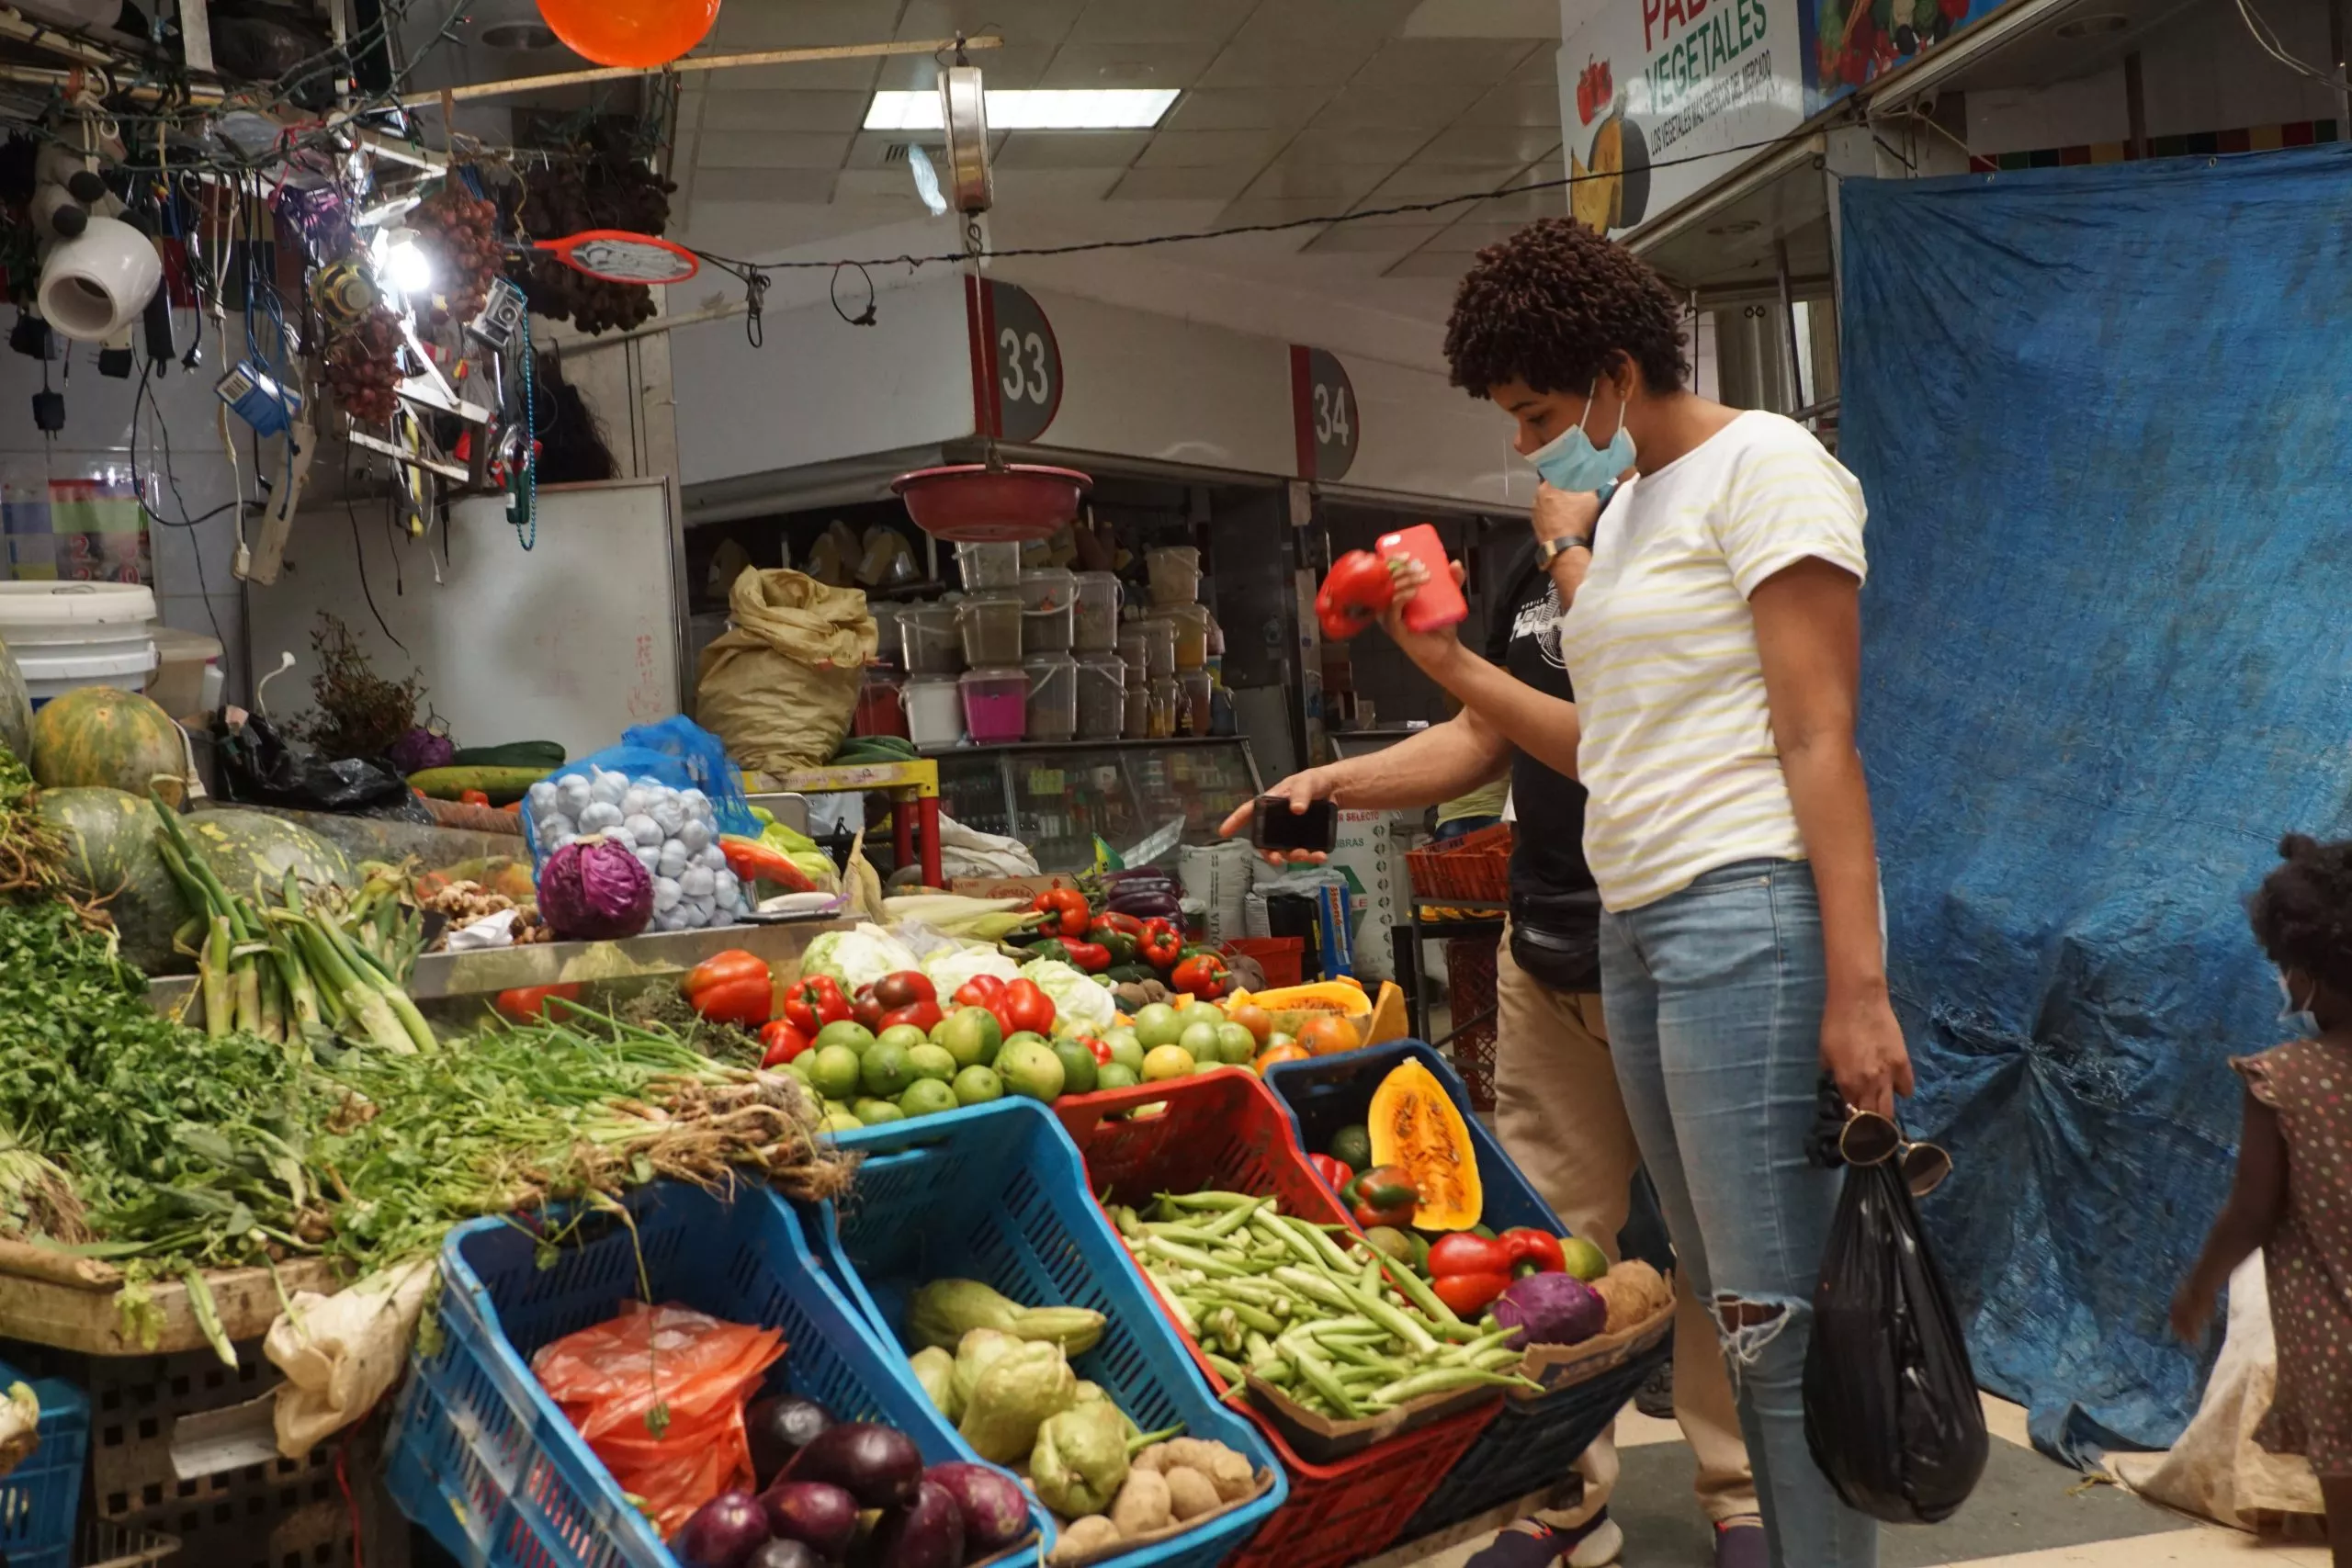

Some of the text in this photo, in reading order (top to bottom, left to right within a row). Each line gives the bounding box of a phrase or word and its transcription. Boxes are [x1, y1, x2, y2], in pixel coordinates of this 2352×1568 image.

[1645, 0, 1767, 115] VEGETALES
[1651, 126, 1662, 156] LOS
[1662, 105, 1691, 148] VEGETALES
[1729, 71, 1743, 103] DEL
[1742, 49, 1771, 95] MERCADO
[1000, 327, 1049, 404] 33
[1314, 383, 1349, 446] 34
